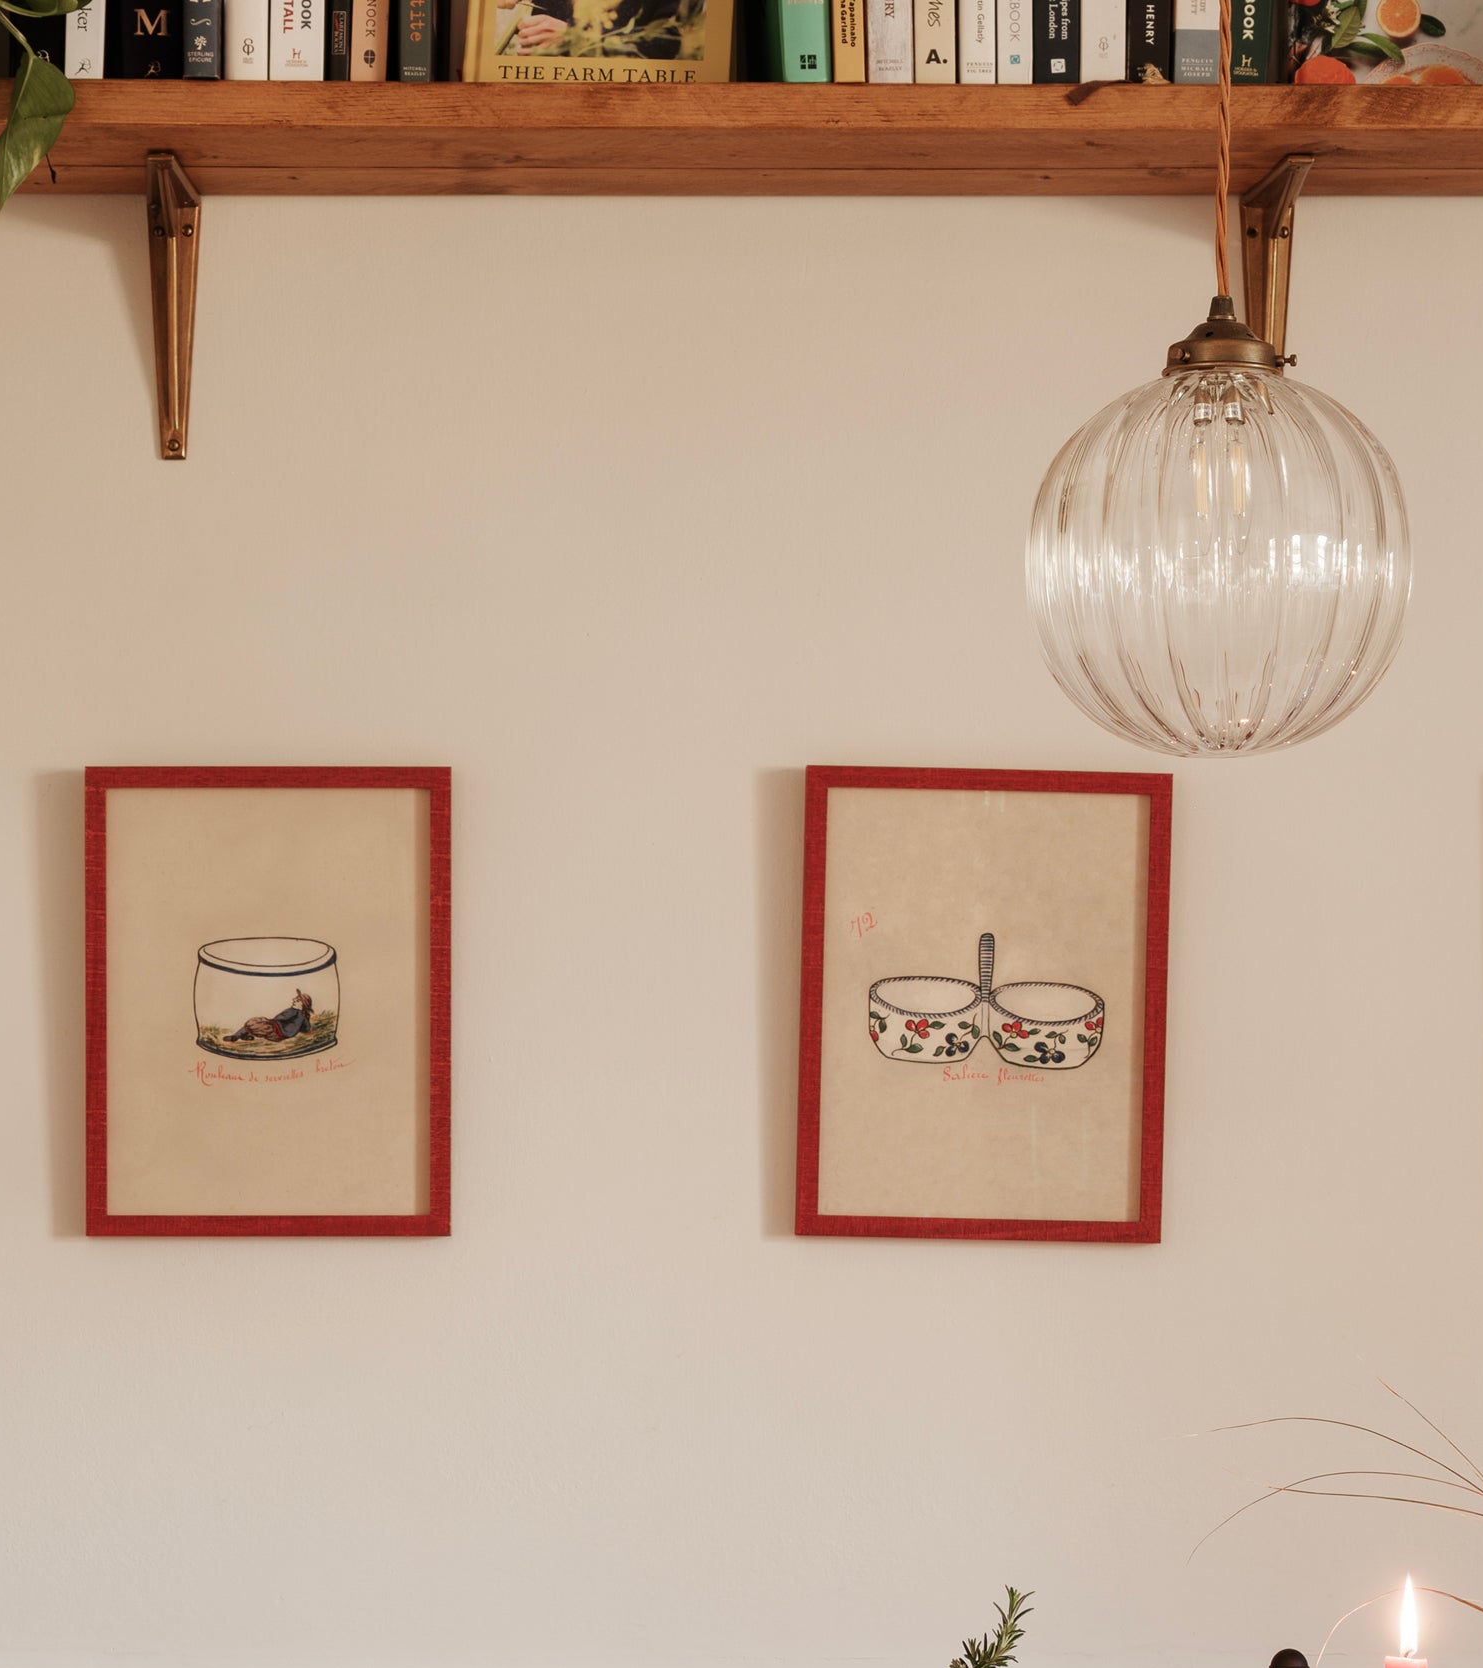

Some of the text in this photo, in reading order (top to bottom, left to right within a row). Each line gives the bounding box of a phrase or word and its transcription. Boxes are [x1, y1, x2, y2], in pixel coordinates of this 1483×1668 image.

[849, 0, 857, 47] apaninaho
[884, 0, 895, 18] RY
[1009, 0, 1021, 42] BOOK
[1049, 4, 1058, 39] London
[1145, 4, 1155, 45] HENRY
[1061, 18, 1071, 40] from
[498, 65, 697, 83] THE FARM TABLE
